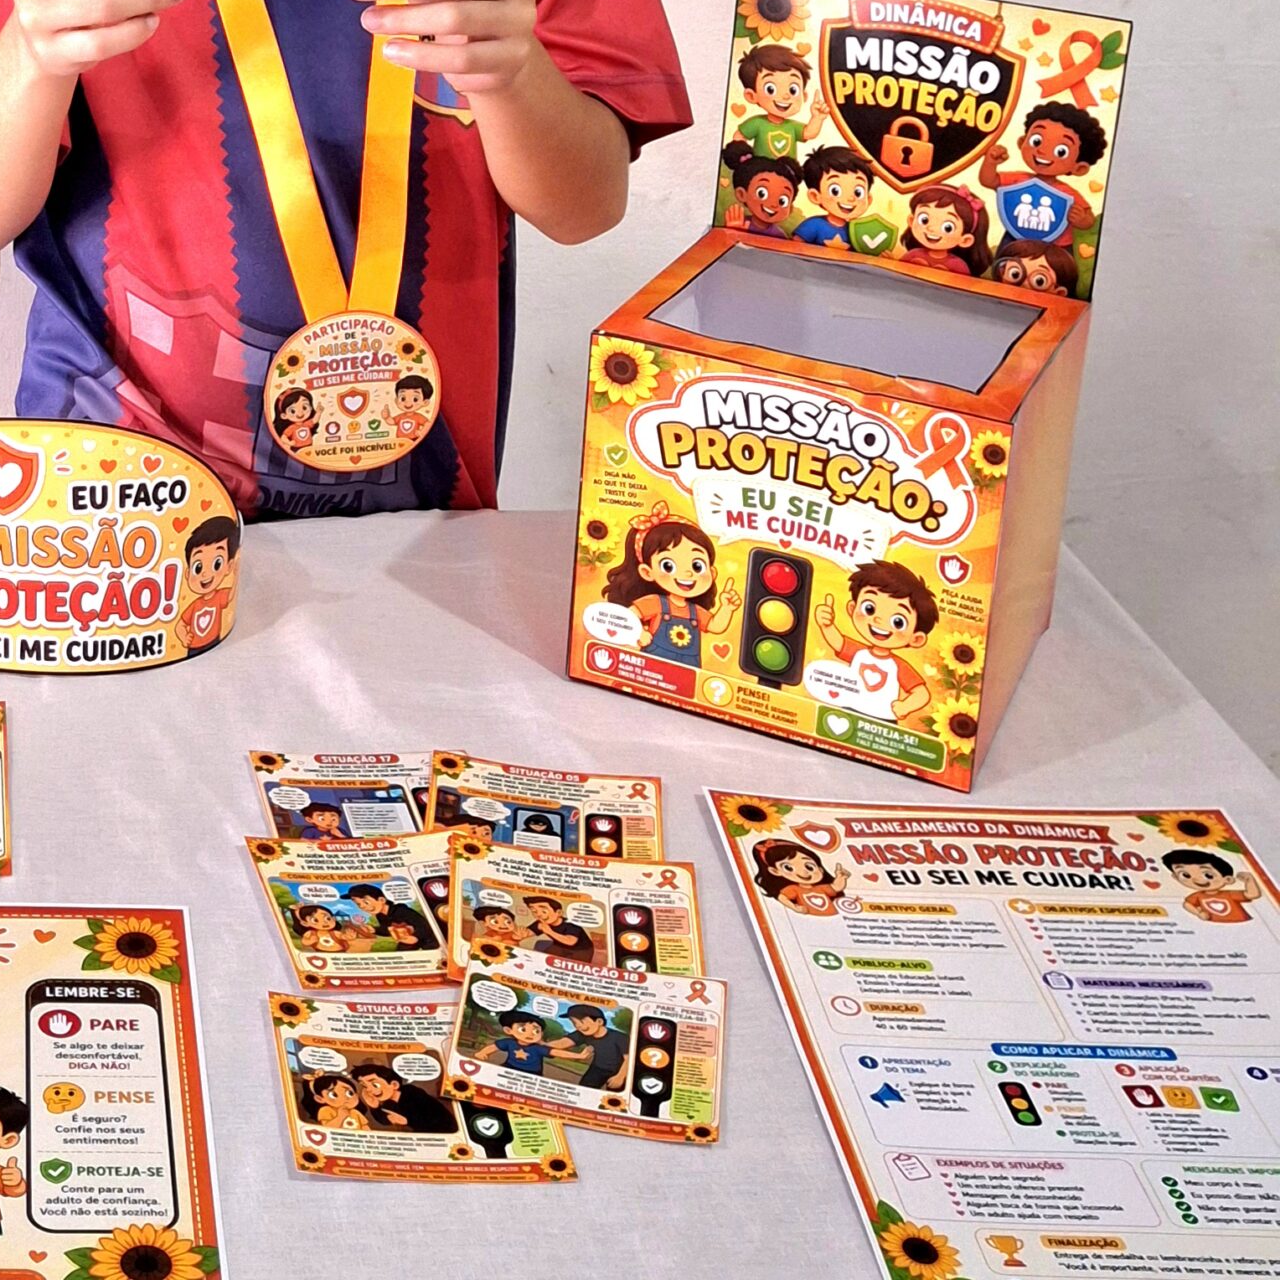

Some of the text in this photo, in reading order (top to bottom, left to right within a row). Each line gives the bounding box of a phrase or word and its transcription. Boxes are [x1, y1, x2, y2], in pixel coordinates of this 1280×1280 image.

[870, 2, 982, 42] DINÂMICA
[845, 36, 1000, 95] MISSÃO
[834, 72, 1003, 133] PROTEÇÃO
[304, 319, 394, 344] PARTICIPAÇÃO
[345, 332, 356, 340] DE
[319, 338, 382, 357] MISSÃO
[308, 352, 397, 374] PROTEÇÃO:
[702, 389, 890, 459] MISSÃO
[657, 422, 947, 533] PROTEÇÃO:
[72, 486, 108, 510] EU
[118, 481, 187, 513] FAÇO
[741, 488, 833, 526] EU SEI
[726, 510, 859, 557] ME CUIDAR!
[20, 640, 57, 661] ME
[66, 633, 164, 661] CUIDAR!
[858, 720, 919, 745] PROTEJA-SE!
[852, 822, 1101, 841] PLANEJAMENTO DA DINÂMICA
[848, 840, 1160, 873] MISSÃO PROTEÇÃO:
[886, 870, 1134, 890] EU SEI ME CUIDAR!
[553, 959, 639, 982] SITUAÇÃO 18
[46, 987, 140, 998] LEMBRE-SE:
[89, 1019, 139, 1031] PARE
[68, 1060, 130, 1070] DIGA NÃO!
[94, 1091, 155, 1104] PENSE
[55, 1125, 92, 1134] Confie
[63, 1137, 138, 1145] sentimentos!
[77, 1166, 164, 1177] PROTEJA-SE
[61, 1185, 94, 1194] Conte
[98, 1186, 123, 1195] para
[46, 1196, 81, 1205] adulto
[102, 1197, 161, 1206] confiança.
[40, 1207, 167, 1217] Você não está sozinho!
